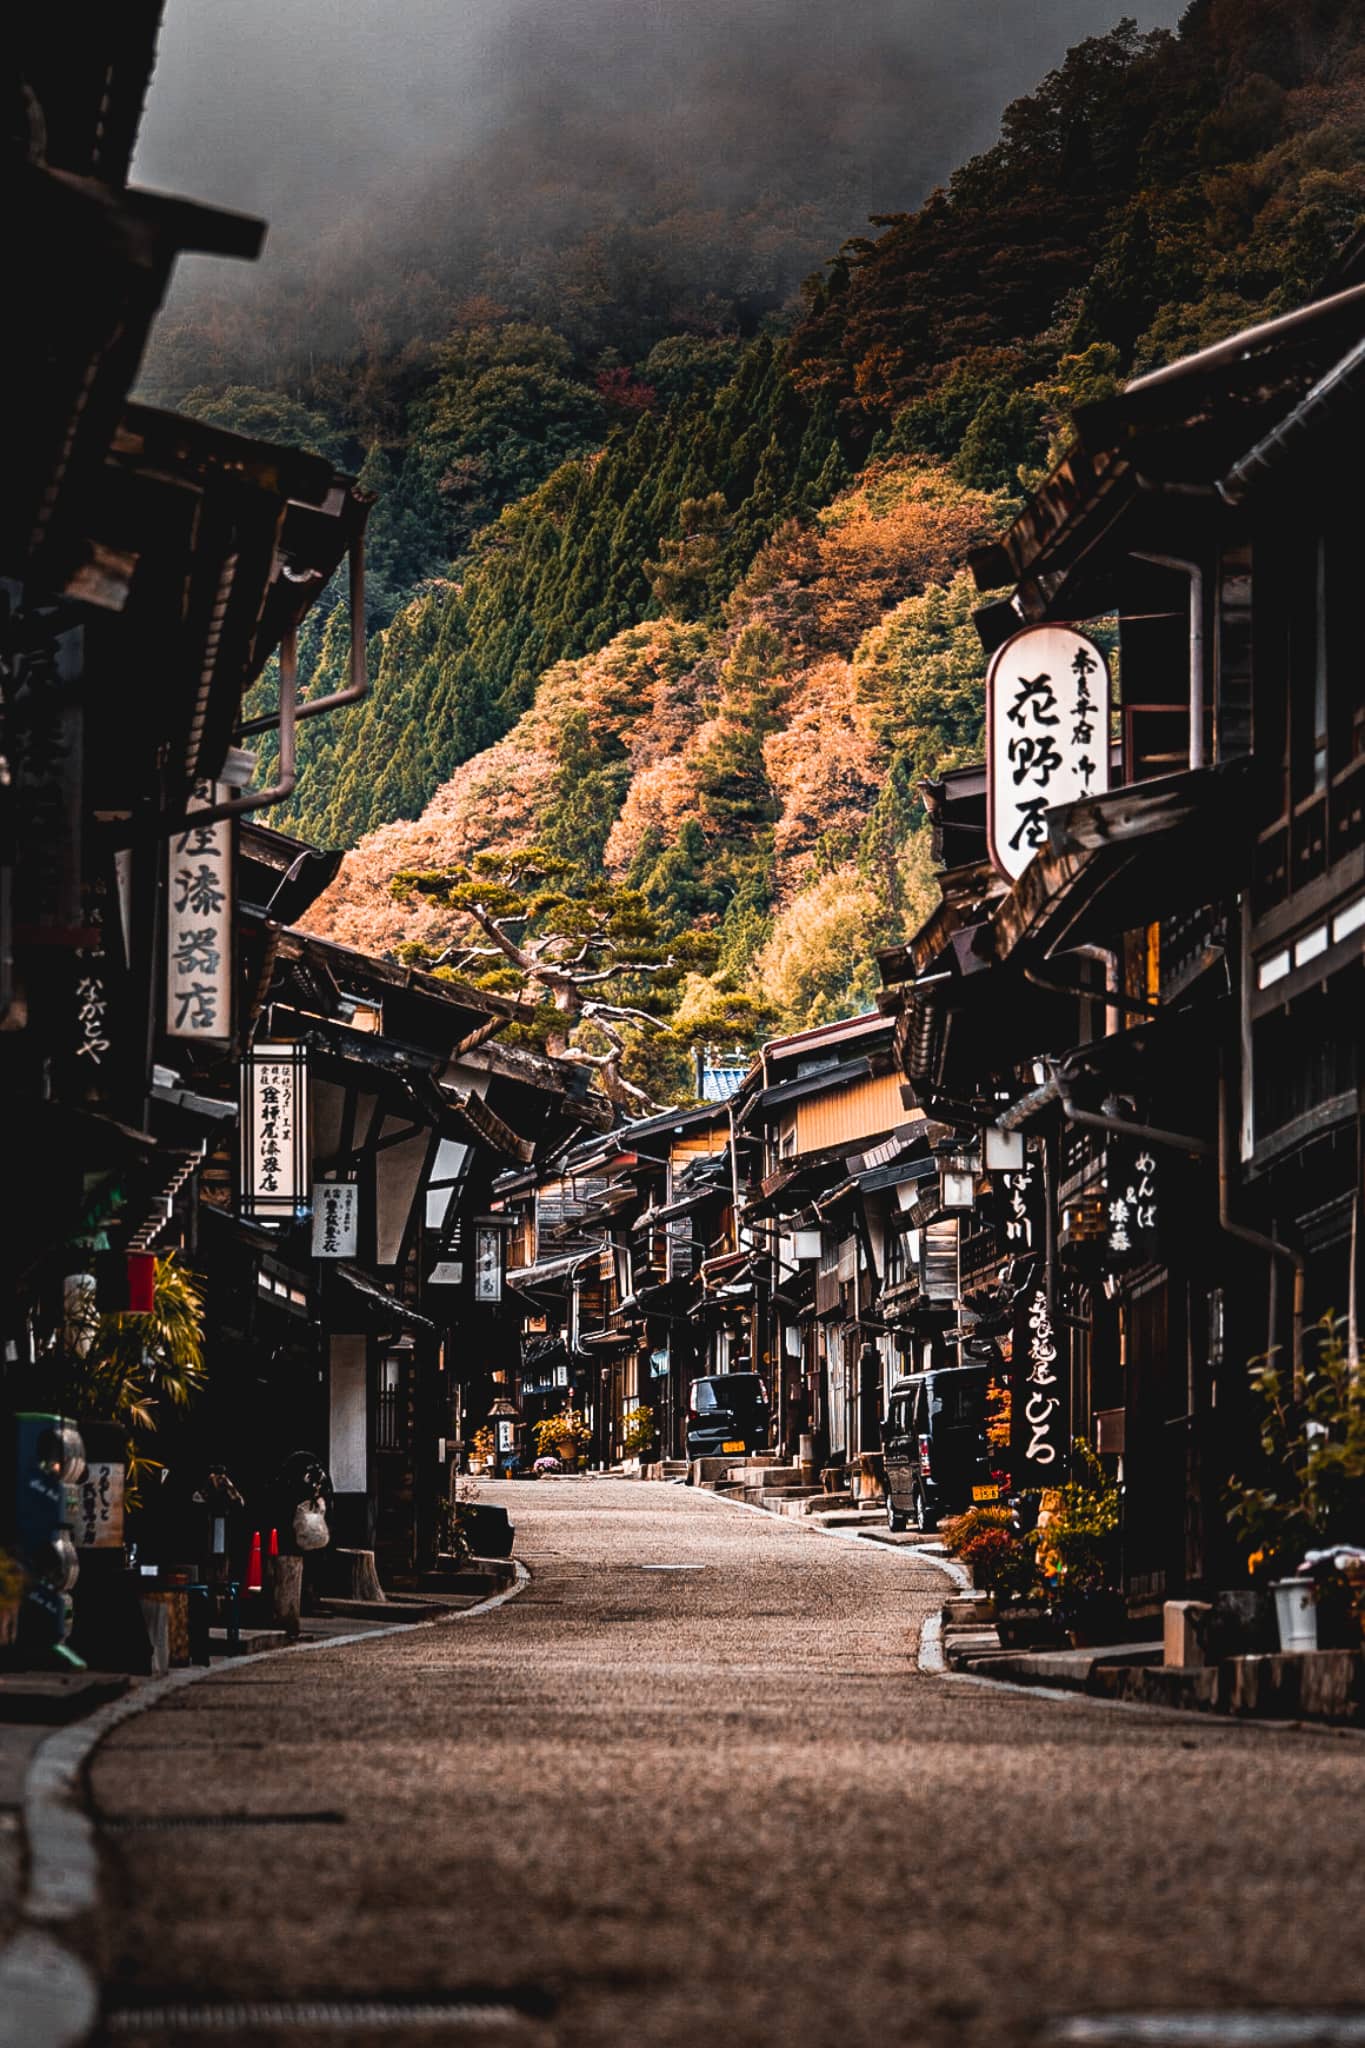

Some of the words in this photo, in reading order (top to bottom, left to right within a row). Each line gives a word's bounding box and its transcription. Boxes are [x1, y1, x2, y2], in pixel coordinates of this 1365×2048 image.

[1006, 673, 1063, 851] 花野屋
[75, 975, 111, 1066] ながとや
